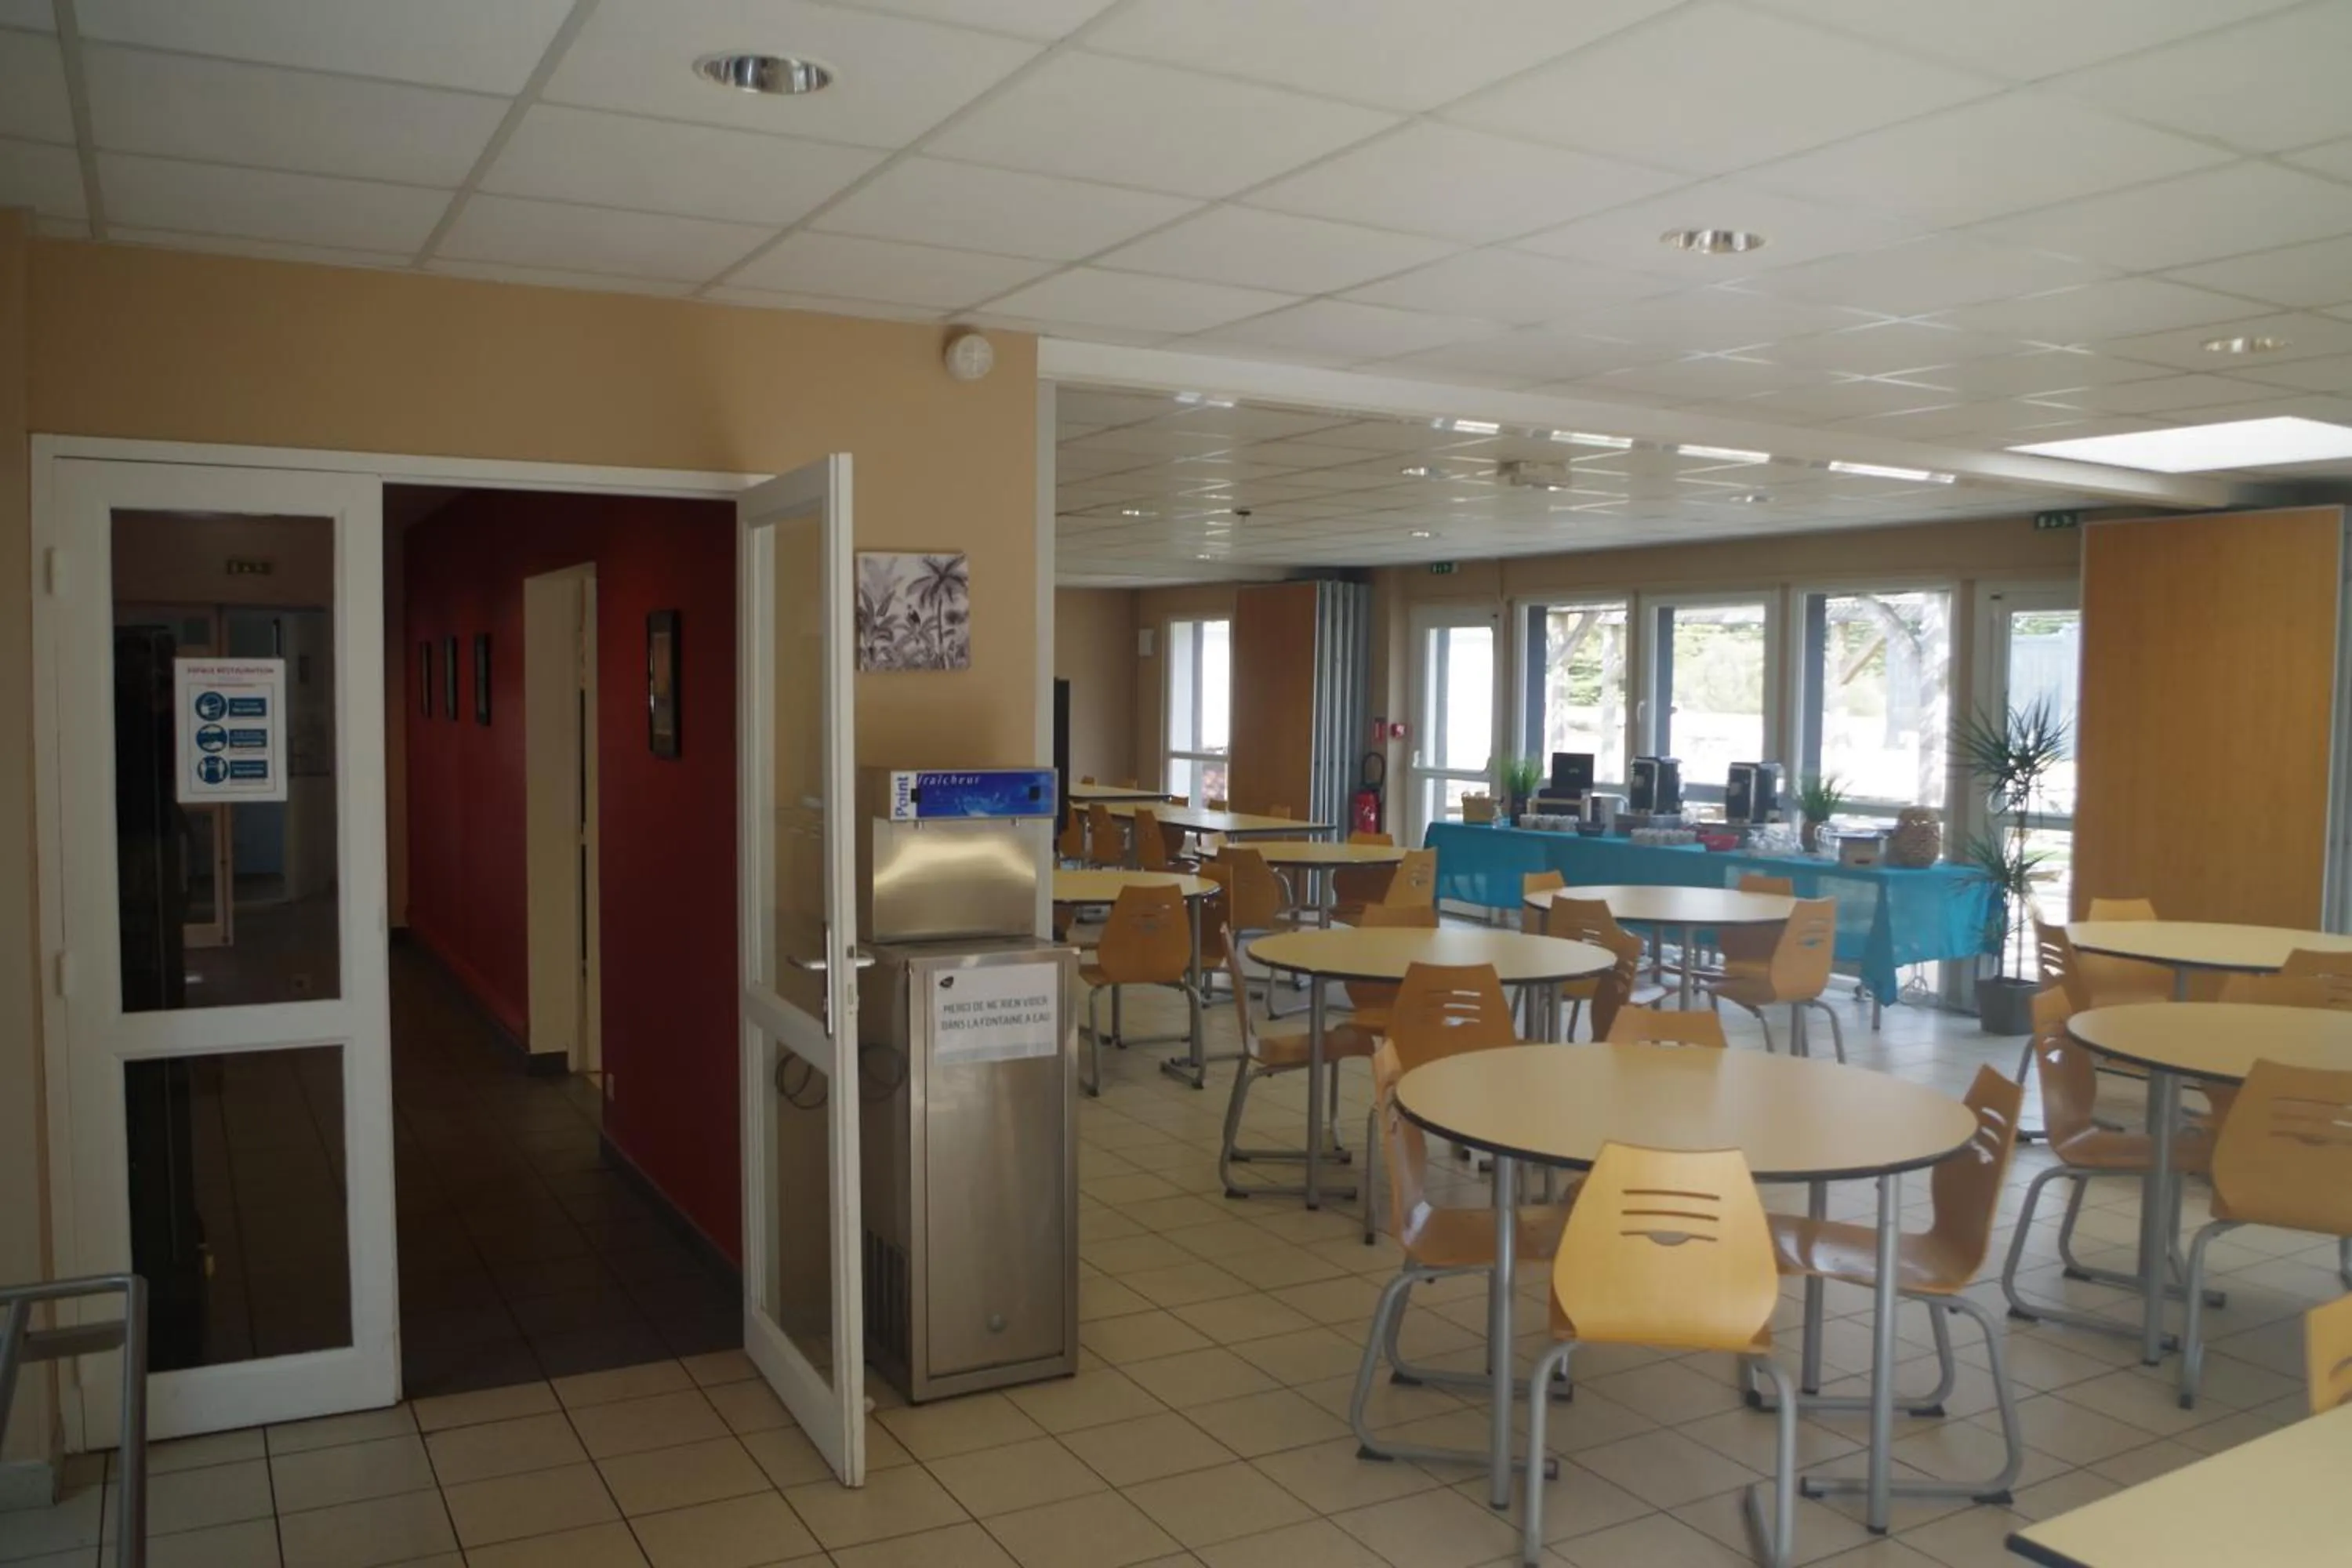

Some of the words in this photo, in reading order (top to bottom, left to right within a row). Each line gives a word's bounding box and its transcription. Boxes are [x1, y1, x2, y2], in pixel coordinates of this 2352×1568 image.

[895, 776, 909, 817] Point
[943, 1002, 971, 1014] MERCI
[973, 1001, 984, 1011] DE
[986, 1000, 998, 1010] NE
[1000, 997, 1021, 1008] RIEN
[941, 1020, 965, 1030] DANS
[967, 1018, 979, 1029] LA
[980, 1014, 1023, 1027] FONTAINE
